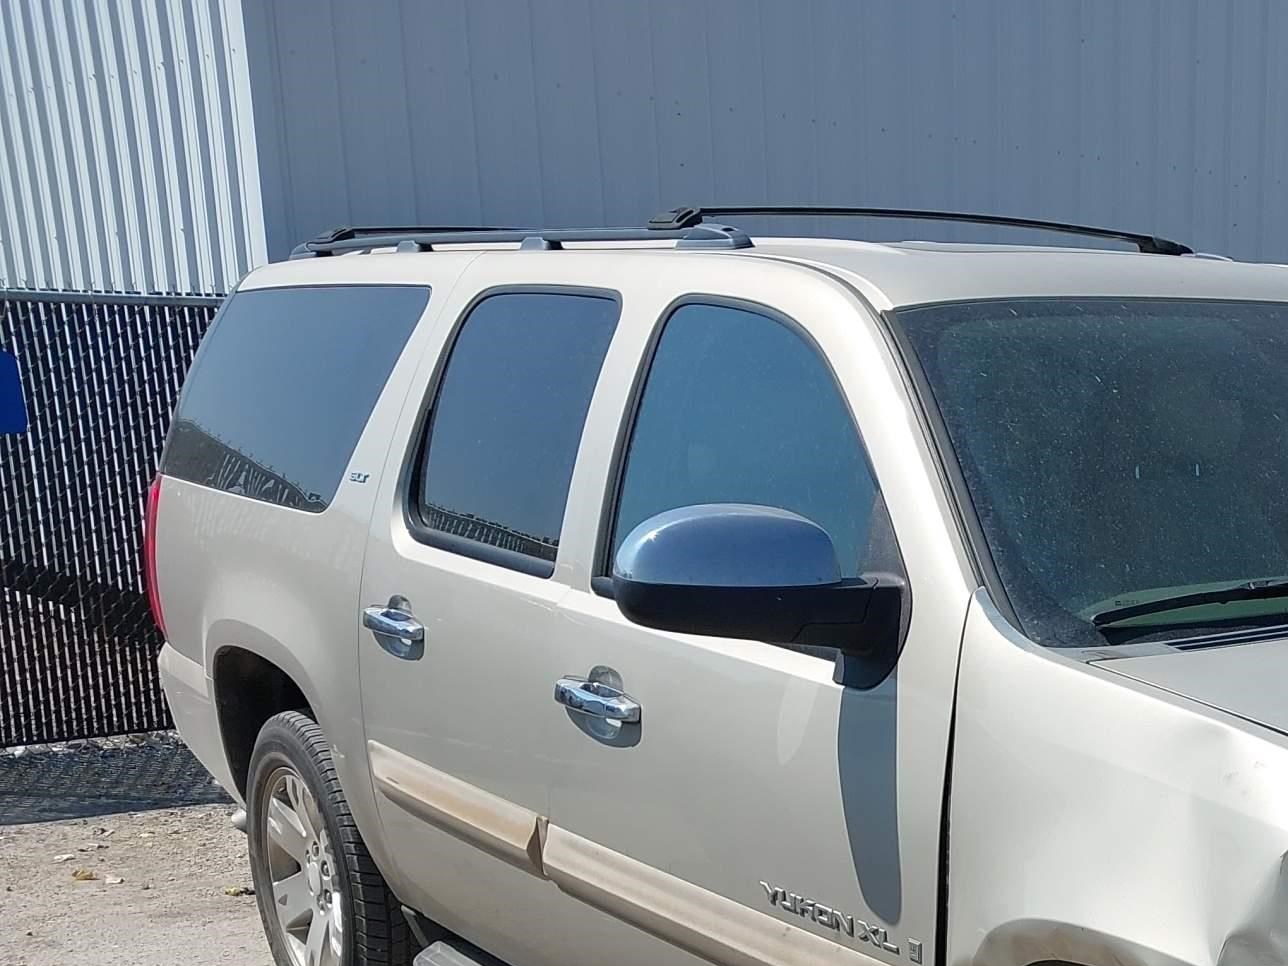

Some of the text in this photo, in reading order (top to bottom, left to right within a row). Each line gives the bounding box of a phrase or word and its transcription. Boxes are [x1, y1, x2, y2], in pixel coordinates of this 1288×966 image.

[349, 472, 370, 484] SLT
[759, 880, 855, 938] YUKON
[856, 919, 900, 956] XL
